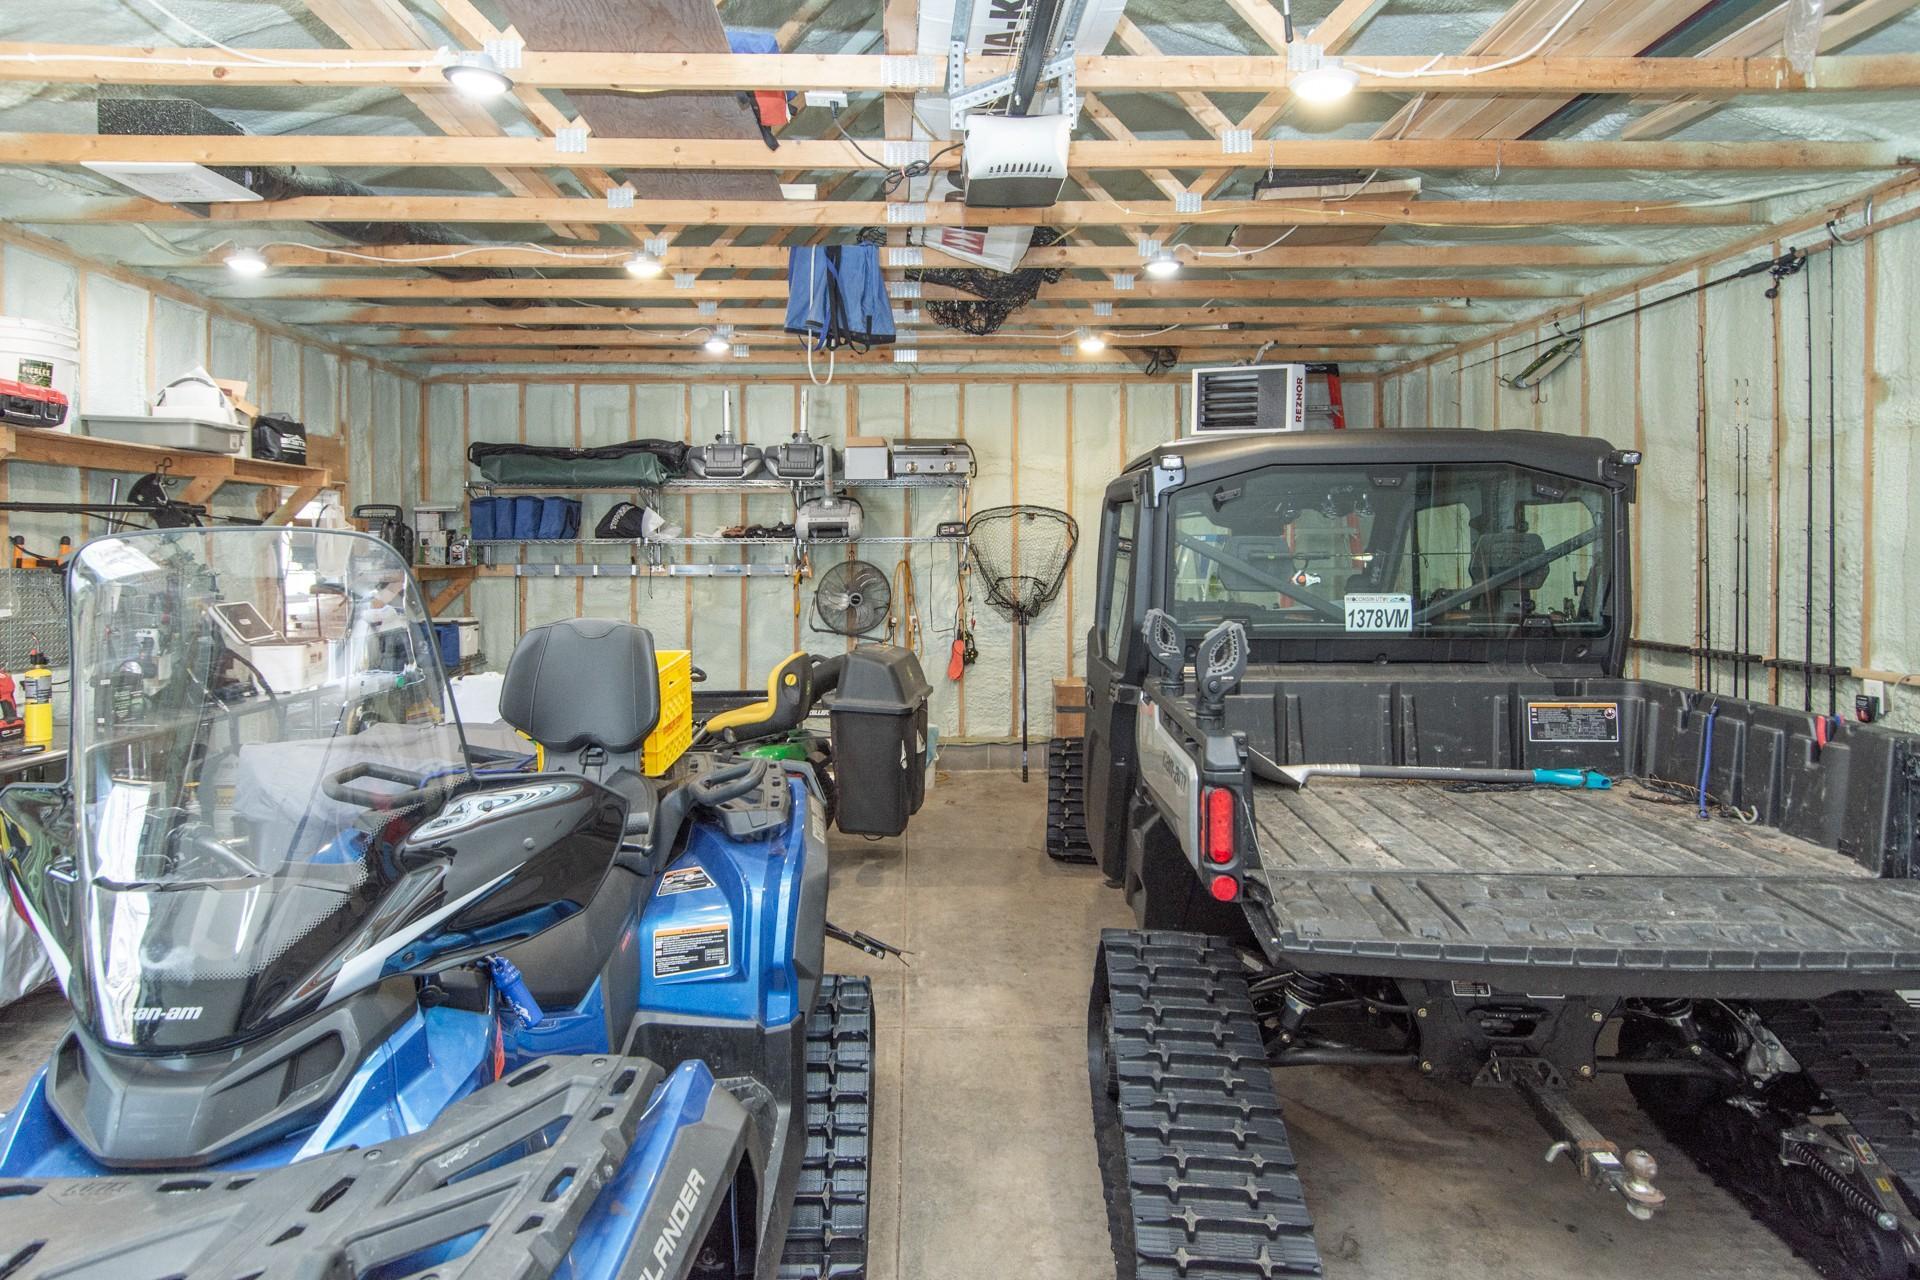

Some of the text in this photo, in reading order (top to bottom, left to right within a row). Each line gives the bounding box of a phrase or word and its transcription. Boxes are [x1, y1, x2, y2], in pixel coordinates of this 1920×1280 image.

[1295, 376, 1304, 423] REZNOR
[1348, 608, 1409, 628] 1378VM
[638, 1168, 706, 1280] LANDER
